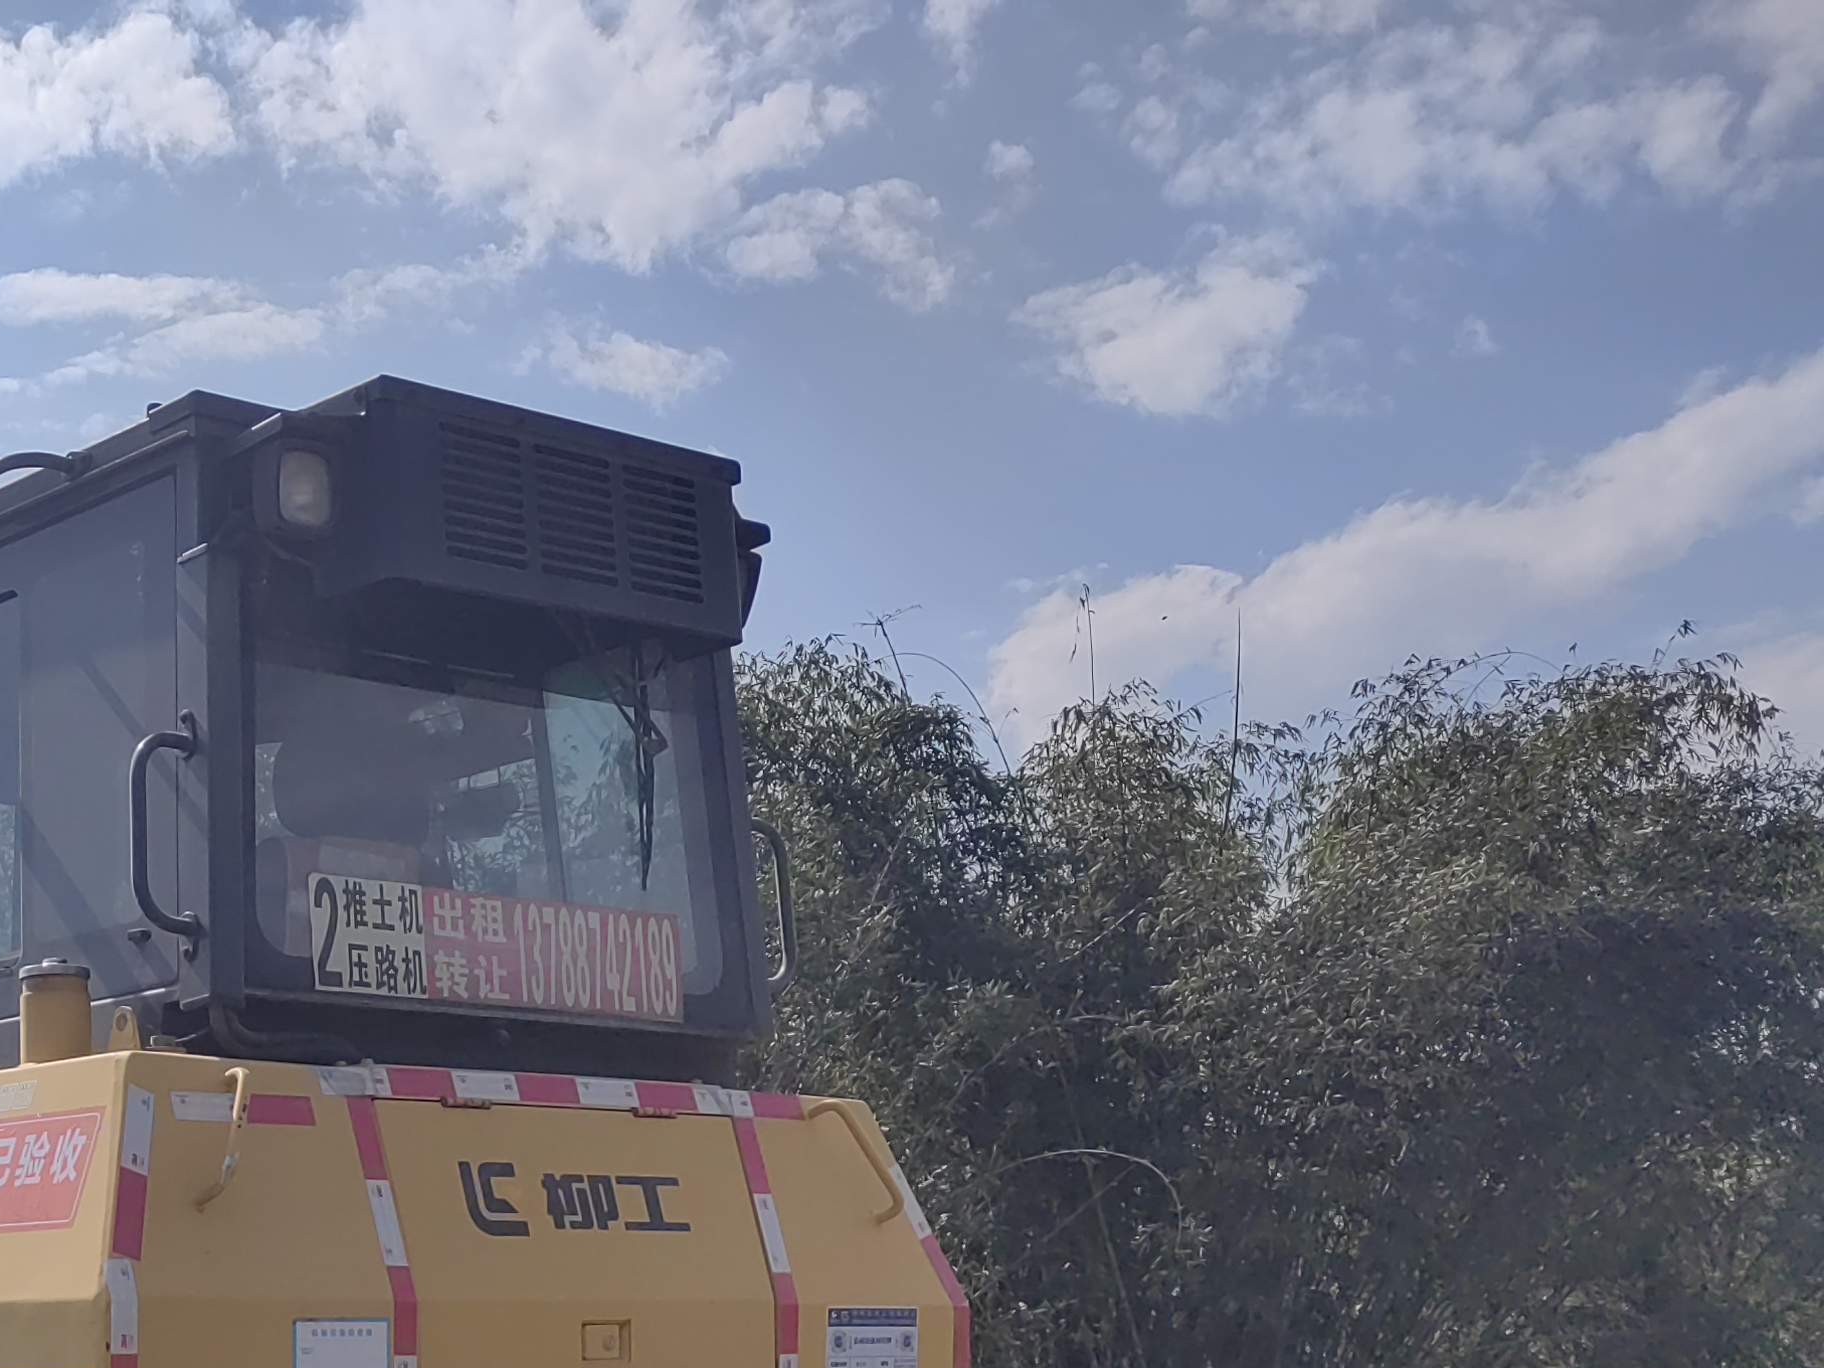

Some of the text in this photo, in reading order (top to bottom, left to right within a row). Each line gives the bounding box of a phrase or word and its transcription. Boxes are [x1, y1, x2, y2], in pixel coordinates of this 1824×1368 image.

[313, 876, 343, 988] 2
[342, 879, 507, 944] 推土机 出租
[348, 943, 510, 1000] 压路机 转让
[514, 903, 676, 1016] 13788742189
[541, 1173, 691, 1232] 柳工
